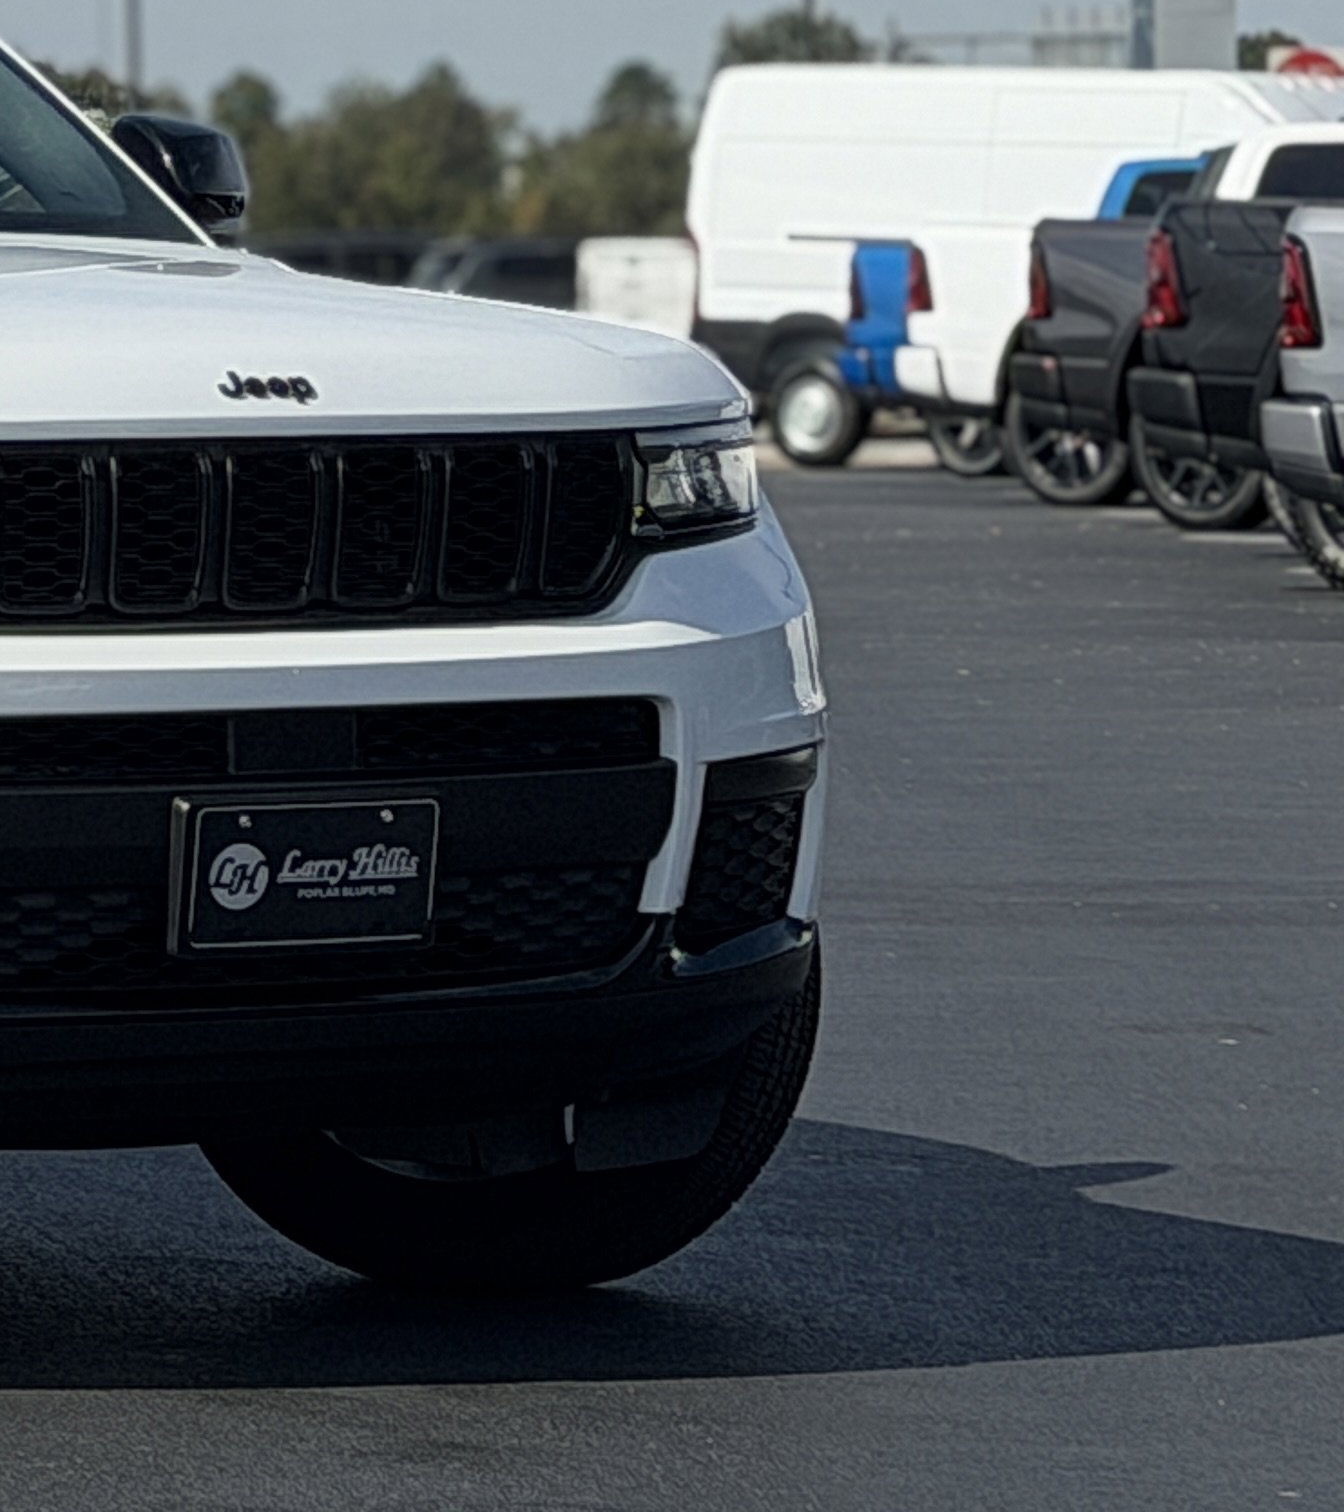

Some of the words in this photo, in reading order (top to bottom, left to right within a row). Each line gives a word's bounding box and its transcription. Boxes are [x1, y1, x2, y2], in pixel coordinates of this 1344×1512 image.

[217, 370, 318, 405] Jeep
[277, 849, 348, 886] Larry
[348, 844, 420, 880] Hillis
